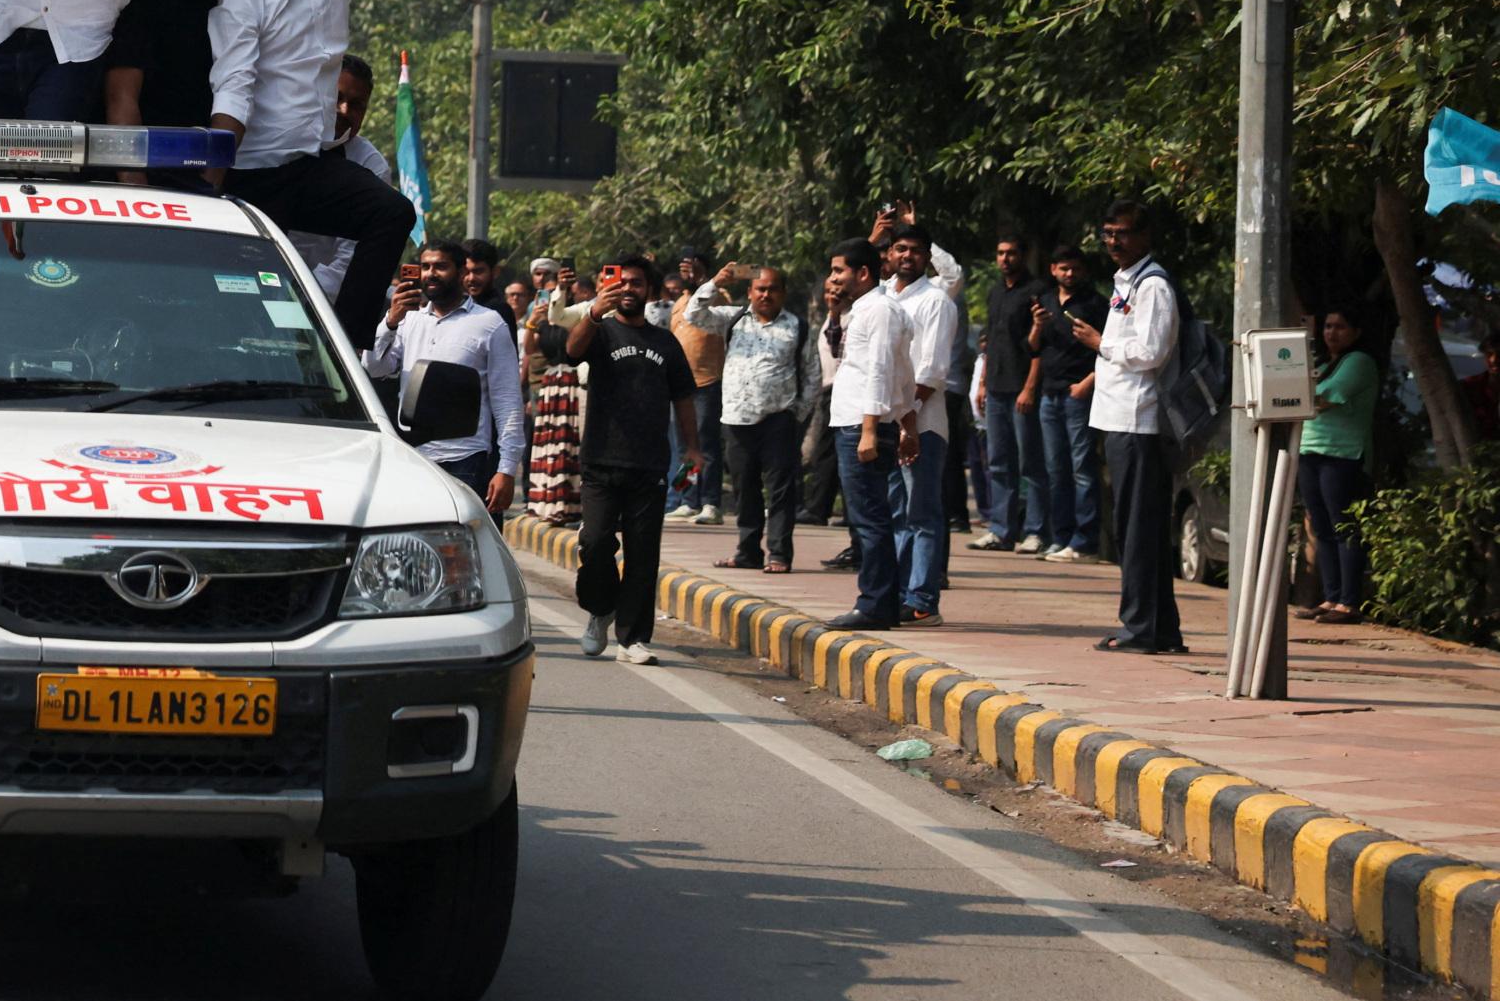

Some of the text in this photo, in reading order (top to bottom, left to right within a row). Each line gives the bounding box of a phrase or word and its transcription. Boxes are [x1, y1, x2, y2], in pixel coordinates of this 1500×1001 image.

[9, 149, 39, 157] SIPHON
[26, 196, 192, 221] POLICE
[124, 480, 324, 521] वाहन
[62, 690, 270, 726] DL1LAN3126
